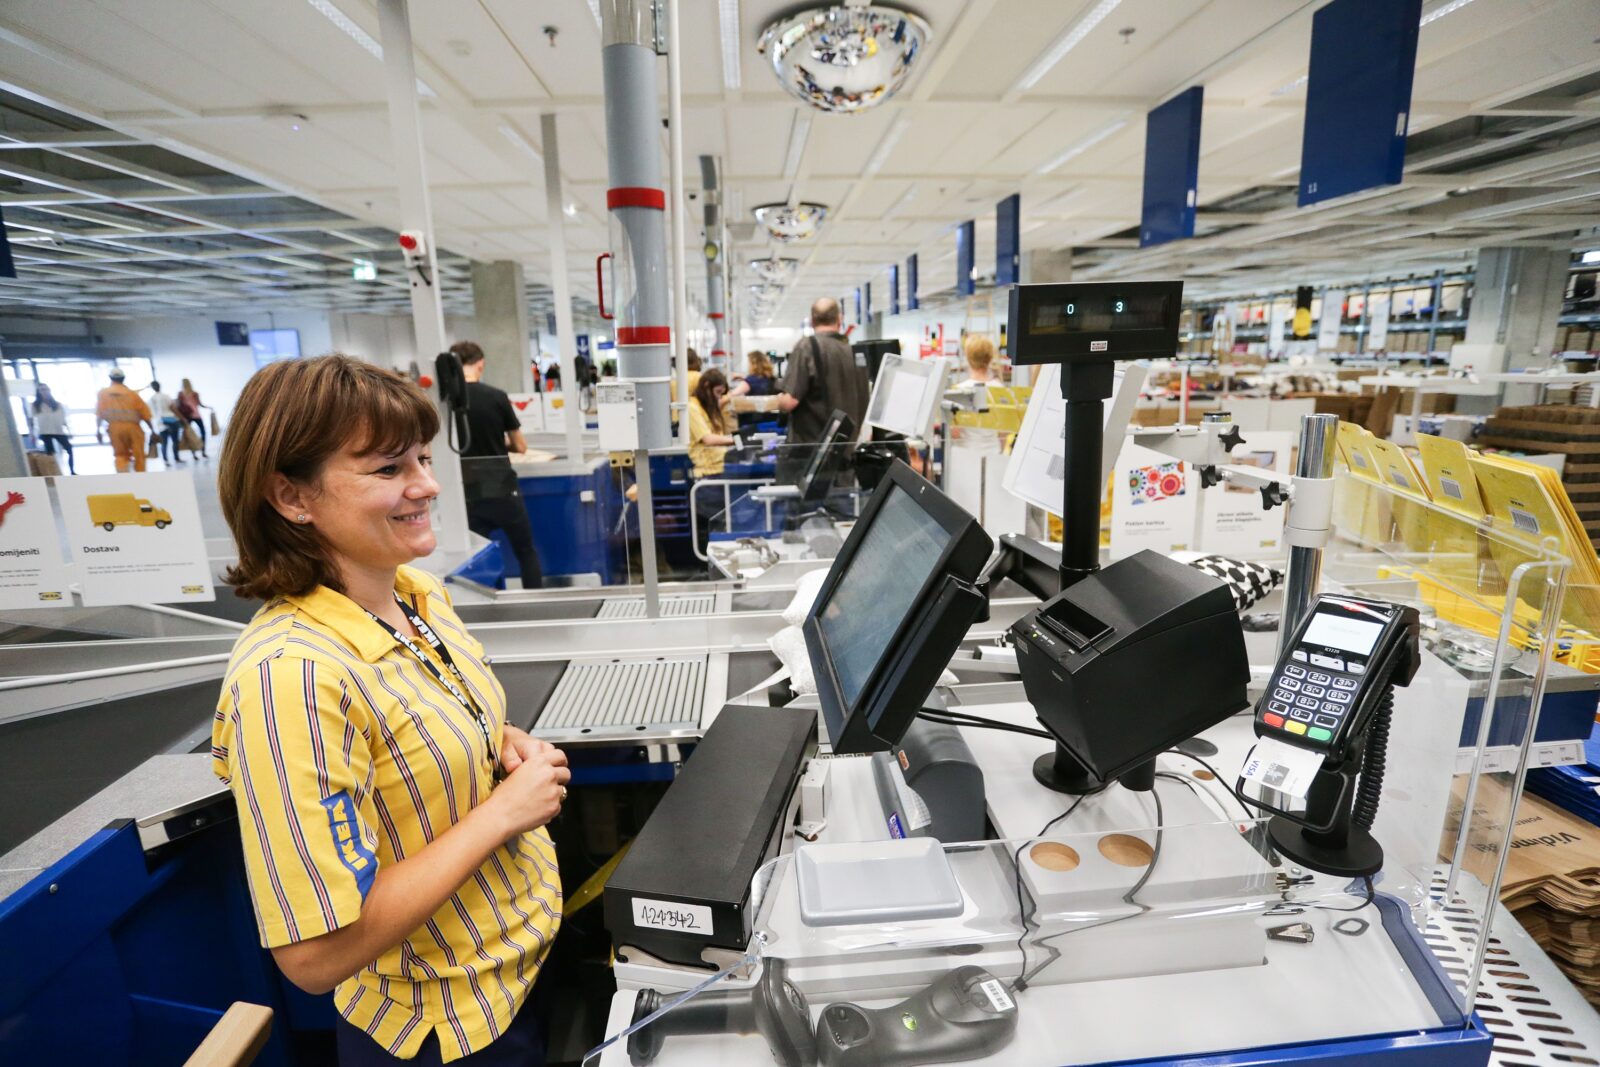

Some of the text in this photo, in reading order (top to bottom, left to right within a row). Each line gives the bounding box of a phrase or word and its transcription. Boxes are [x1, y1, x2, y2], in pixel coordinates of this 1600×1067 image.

[1066, 301, 1124, 315] 0 3
[83, 545, 120, 555] Dostava
[393, 630, 426, 662] IKEA
[411, 614, 441, 648] IKEA
[439, 674, 466, 706] IKEA
[1245, 759, 1260, 777] VISA
[333, 799, 369, 871] IKEA
